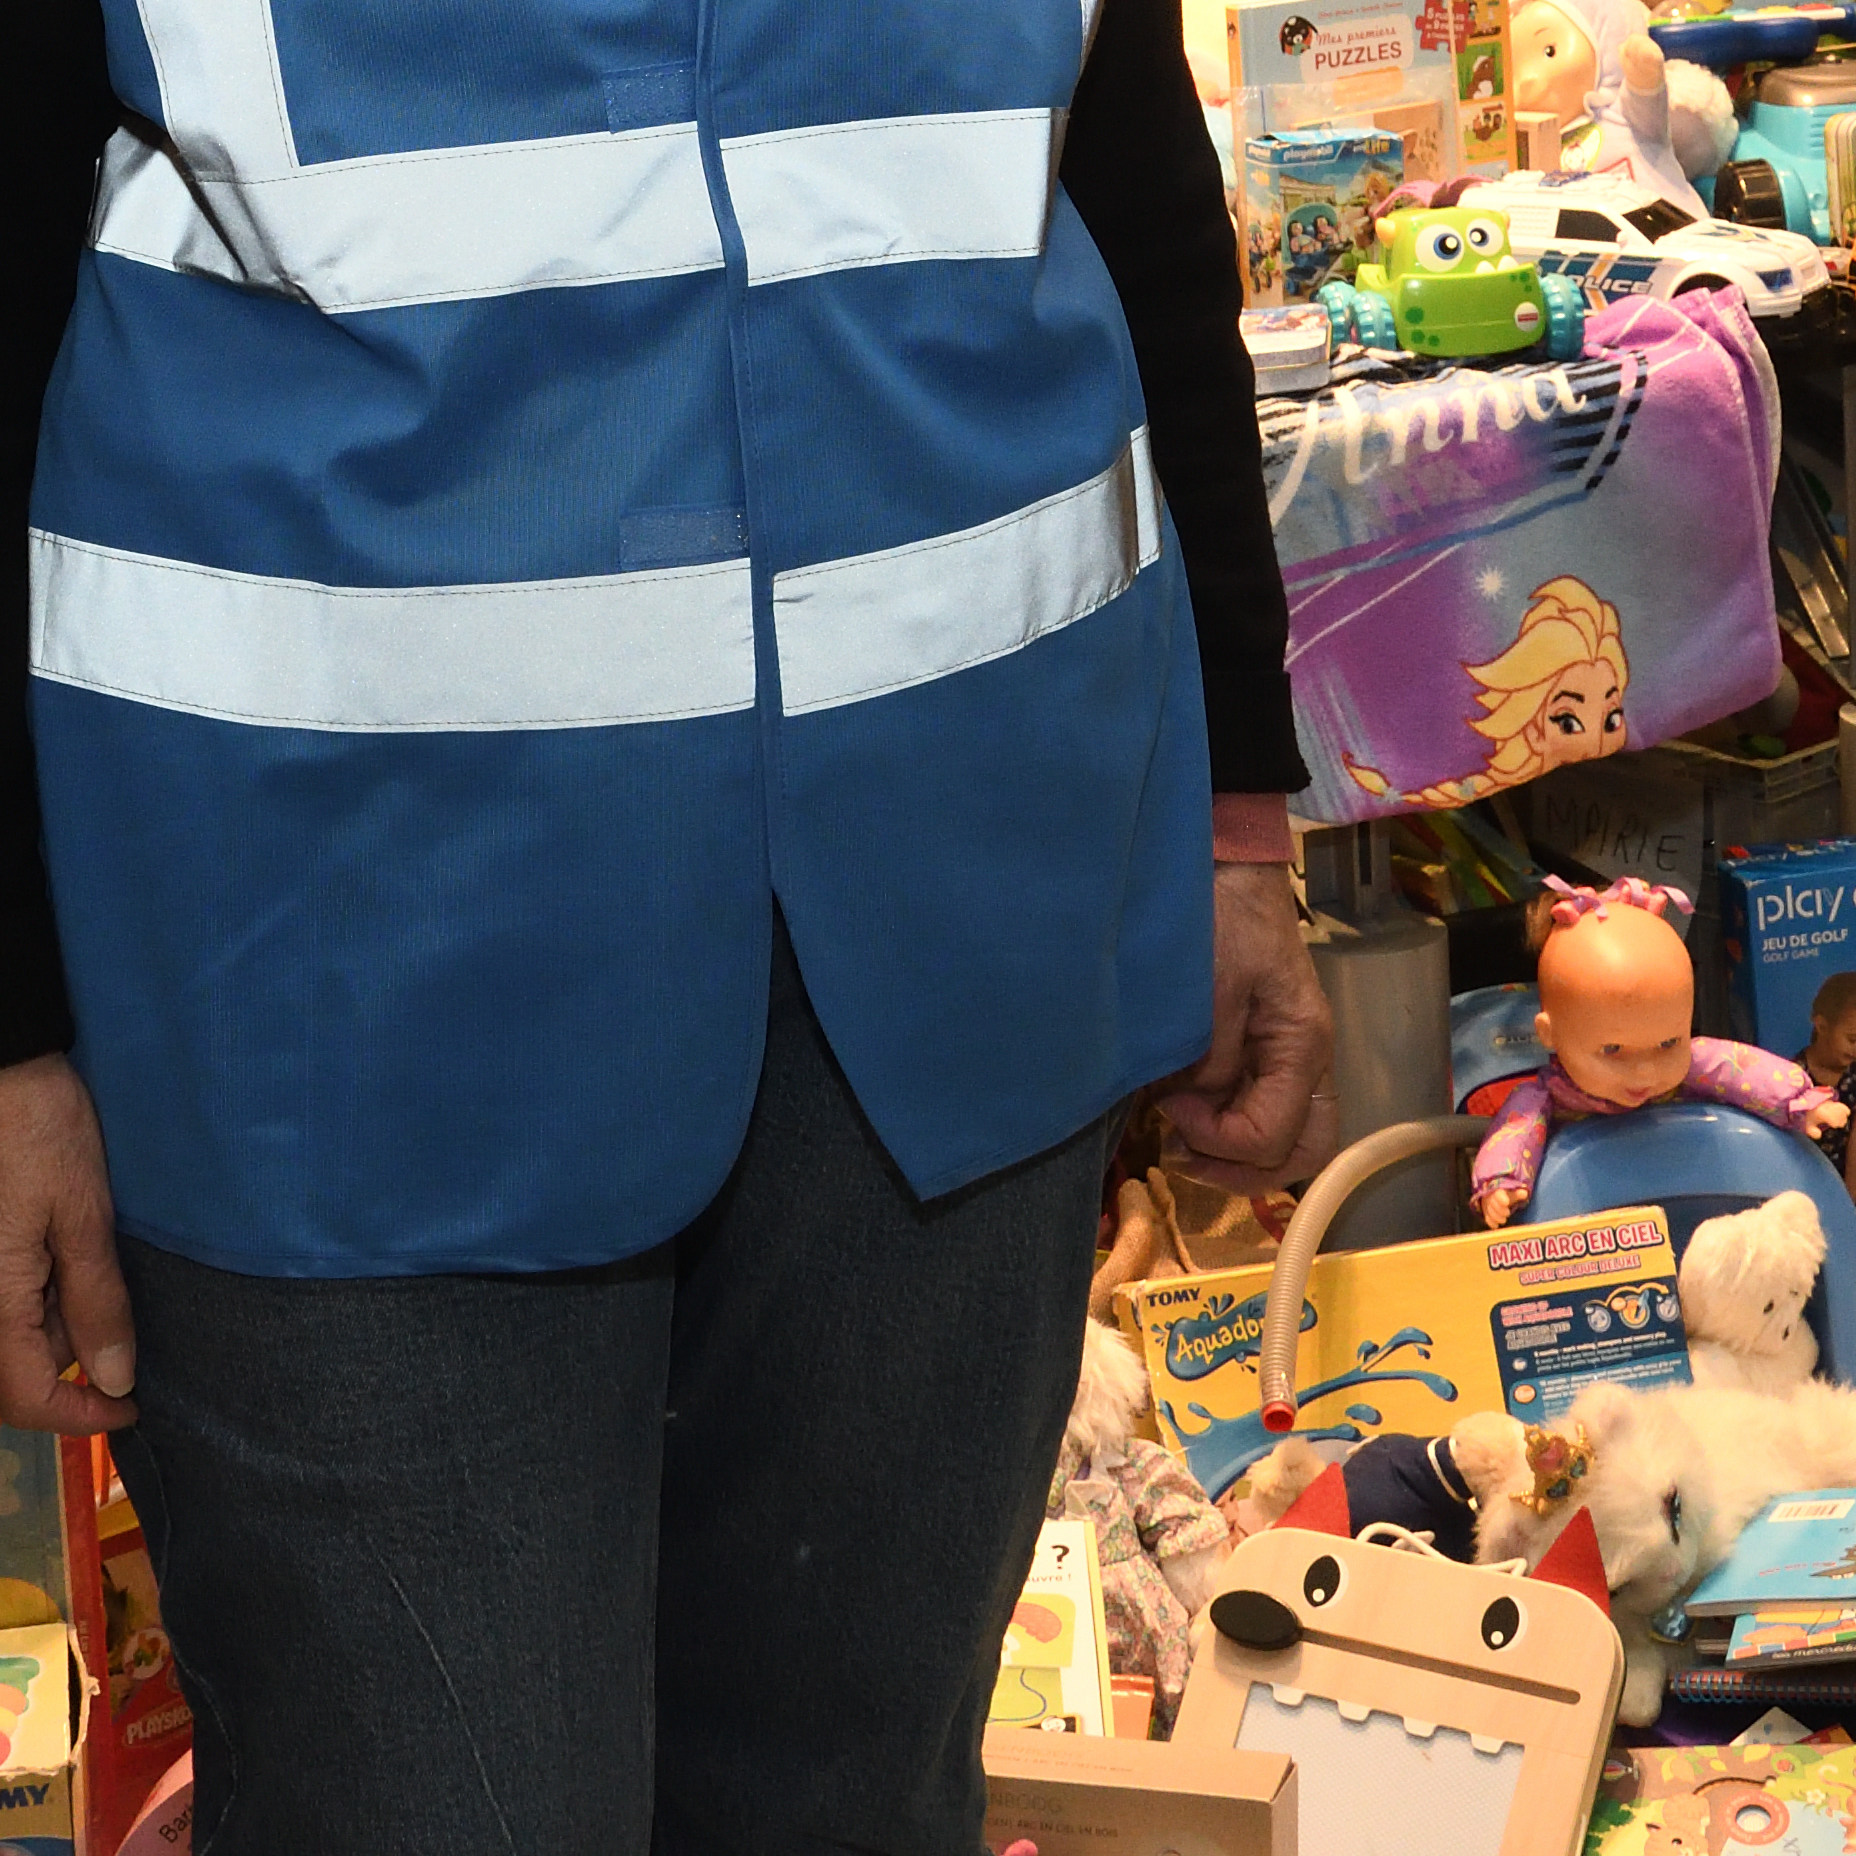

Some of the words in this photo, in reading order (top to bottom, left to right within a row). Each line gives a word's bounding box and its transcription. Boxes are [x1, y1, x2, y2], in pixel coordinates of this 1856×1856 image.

[1317, 32, 1343, 46] Mes
[1346, 26, 1397, 46] premiers
[1315, 41, 1402, 70] PUZZLES
[1569, 274, 1653, 295] OLICE
[1756, 885, 1844, 932] play
[1762, 936, 1787, 953] JEU
[1789, 933, 1808, 949] DE
[1811, 928, 1849, 945] GOLF
[1763, 950, 1790, 964] GOLF
[1490, 1237, 1543, 1269] MAXI
[1545, 1233, 1585, 1260] ARC
[1587, 1227, 1617, 1253] EN
[1617, 1221, 1664, 1249] CIEL
[1519, 1267, 1555, 1285] SUPER
[1556, 1261, 1598, 1279] COLOUR
[1599, 1254, 1641, 1272] DELUXE
[1146, 1287, 1201, 1308] TOMY
[1175, 1312, 1305, 1365] Aquado
